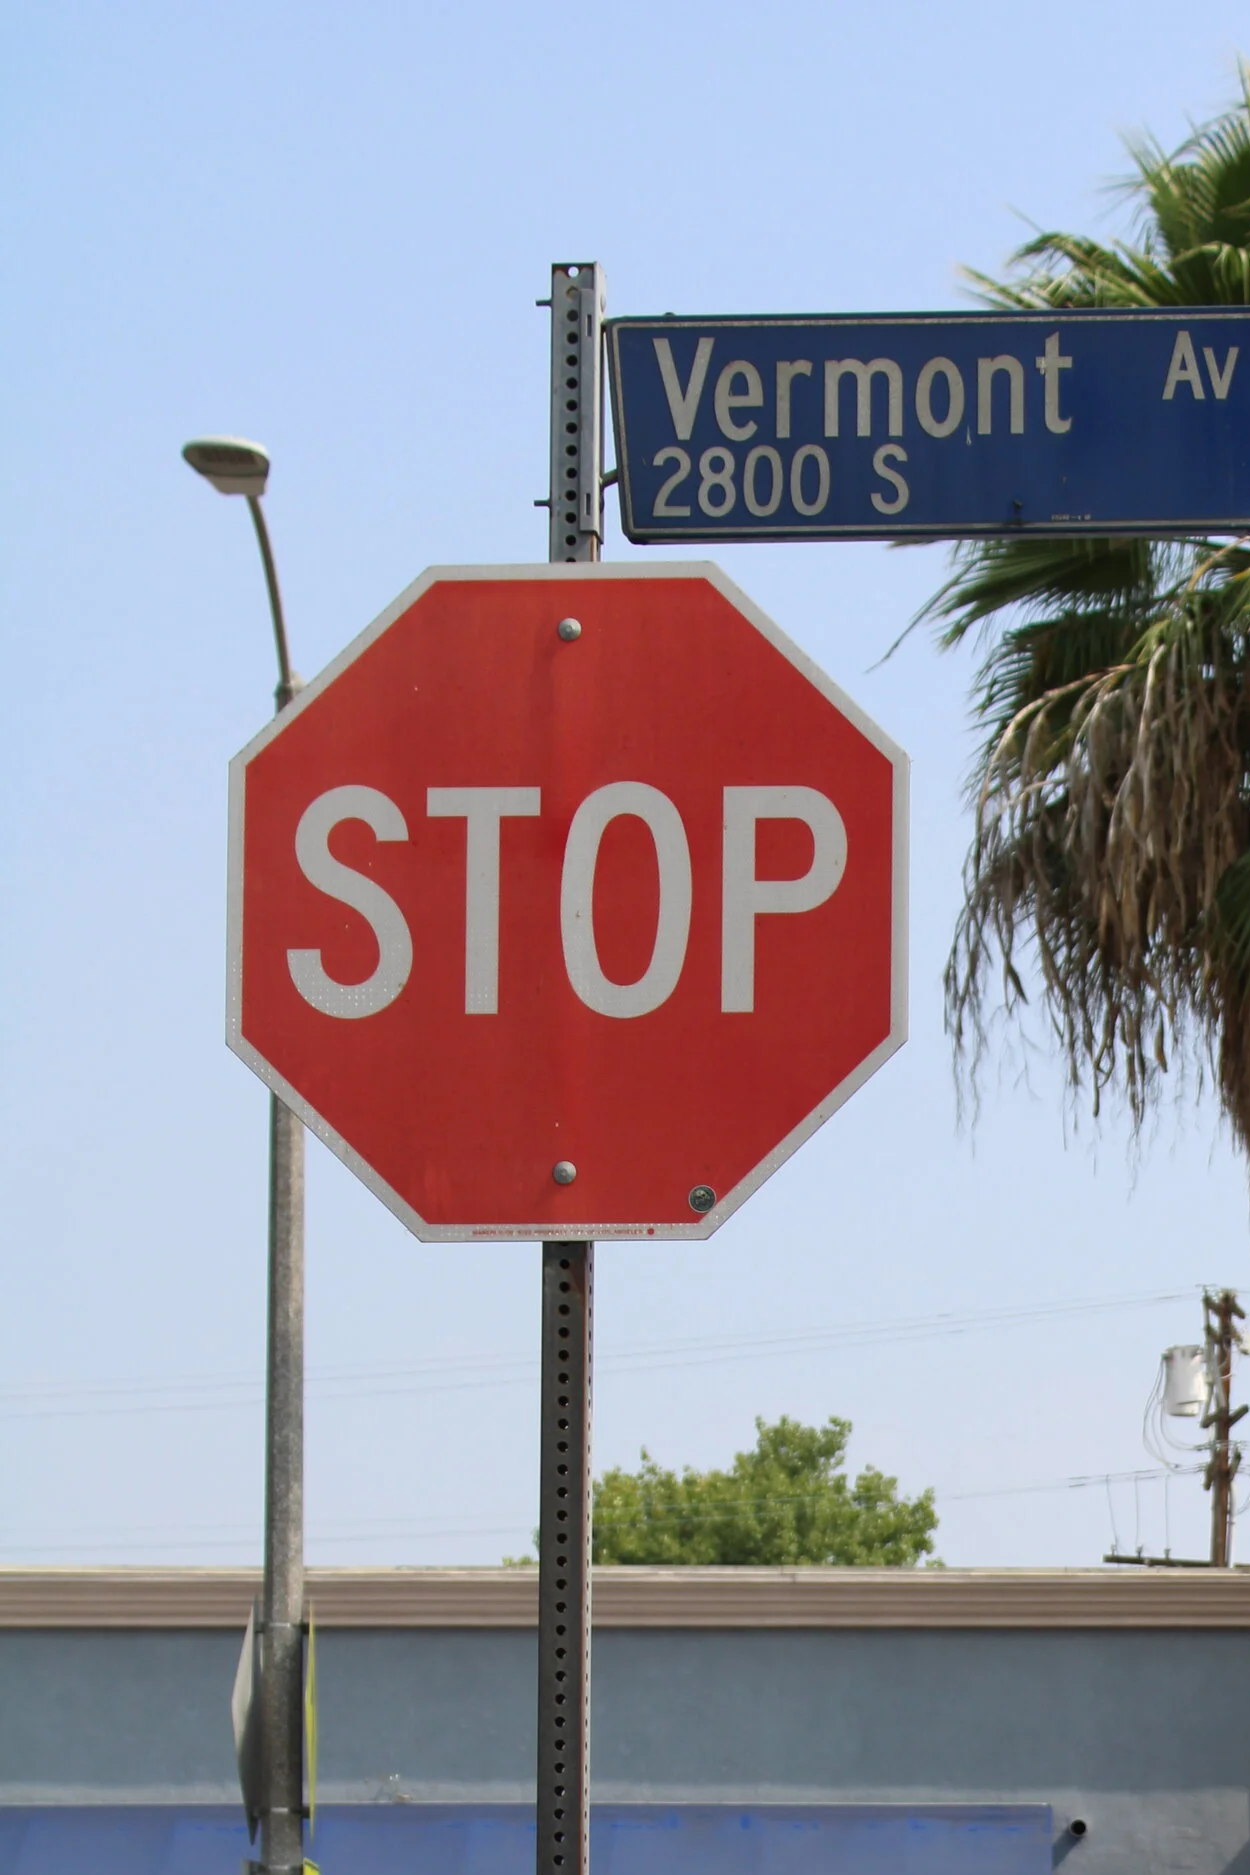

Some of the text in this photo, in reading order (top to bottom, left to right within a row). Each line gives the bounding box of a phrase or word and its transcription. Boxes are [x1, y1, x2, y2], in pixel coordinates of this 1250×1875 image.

[652, 330, 1240, 442] Vermont Av
[652, 443, 911, 518] 2800 S
[286, 780, 849, 1020] STOP
